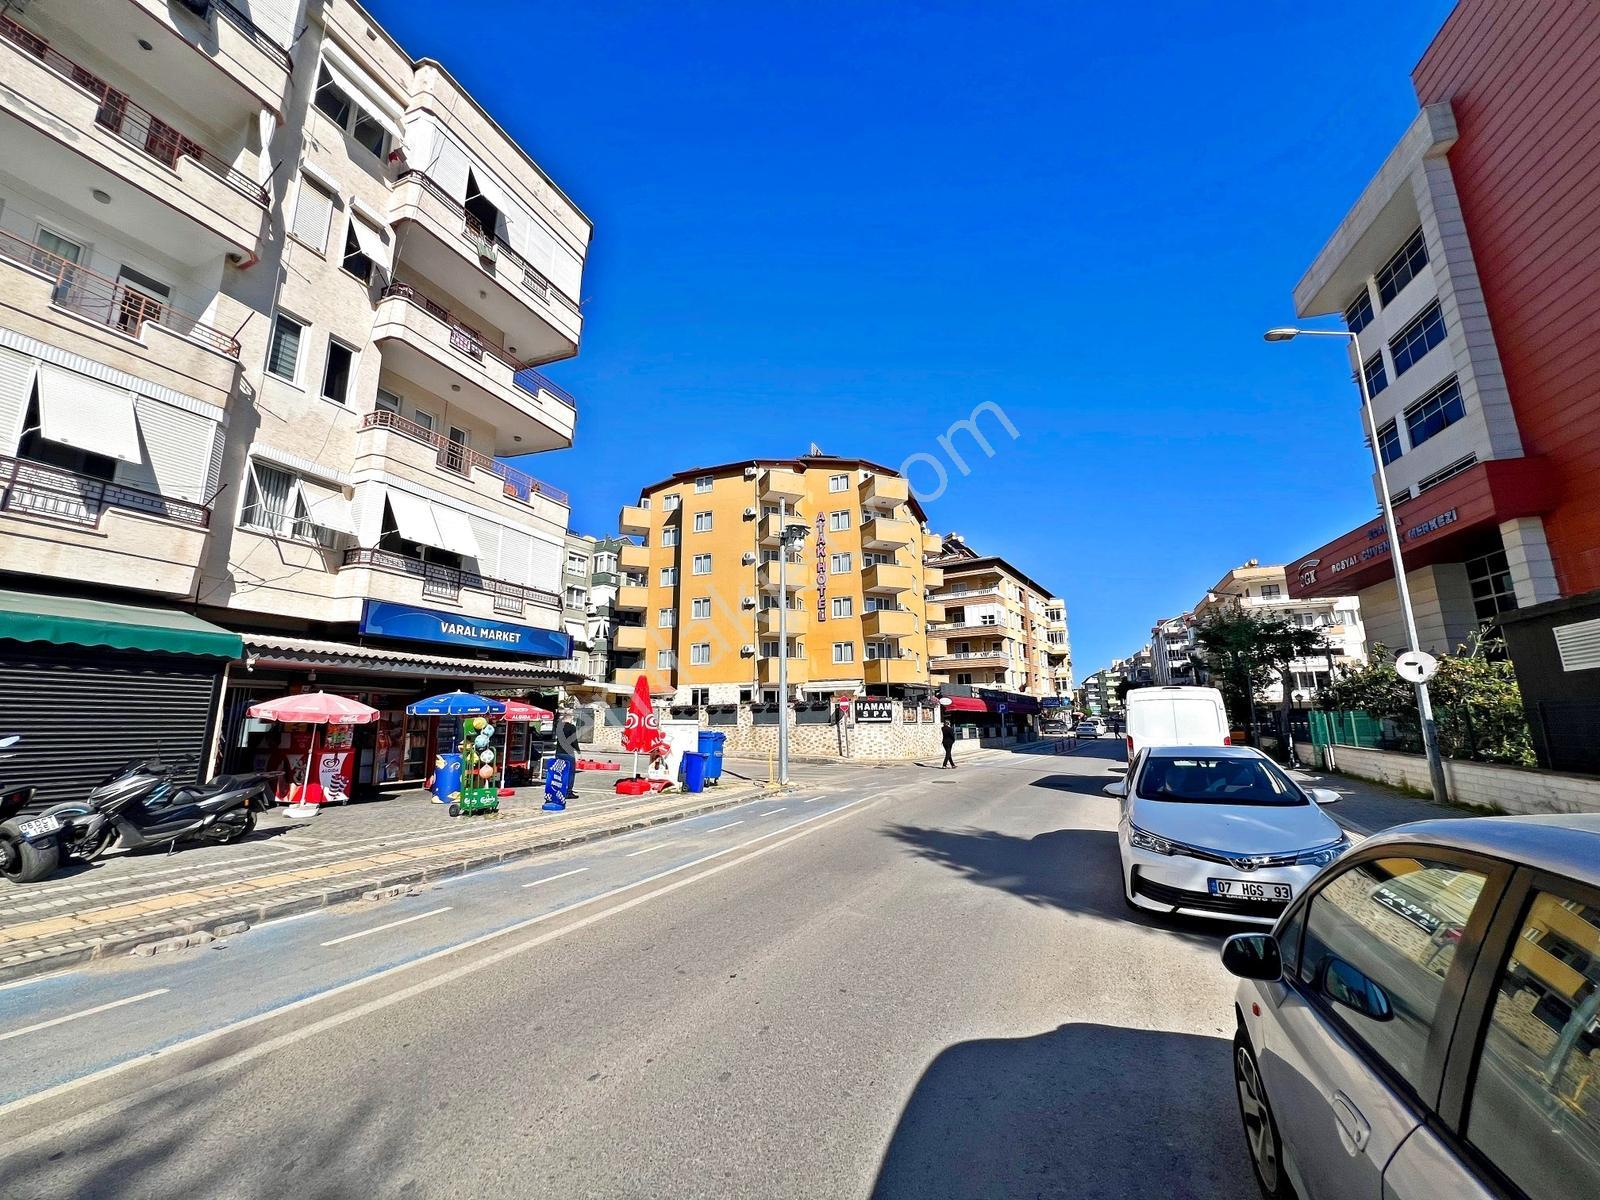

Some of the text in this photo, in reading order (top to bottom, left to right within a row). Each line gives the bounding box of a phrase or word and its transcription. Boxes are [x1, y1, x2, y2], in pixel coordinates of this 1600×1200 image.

[816, 511, 827, 622] ATAK HOTEL
[440, 622, 521, 644] VARAL MARKET
[856, 702, 892, 711] HAMAM
[999, 703, 1006, 712] P
[1218, 881, 1231, 893] 07
[1241, 883, 1264, 897] HGS
[1273, 886, 1289, 898] 93
